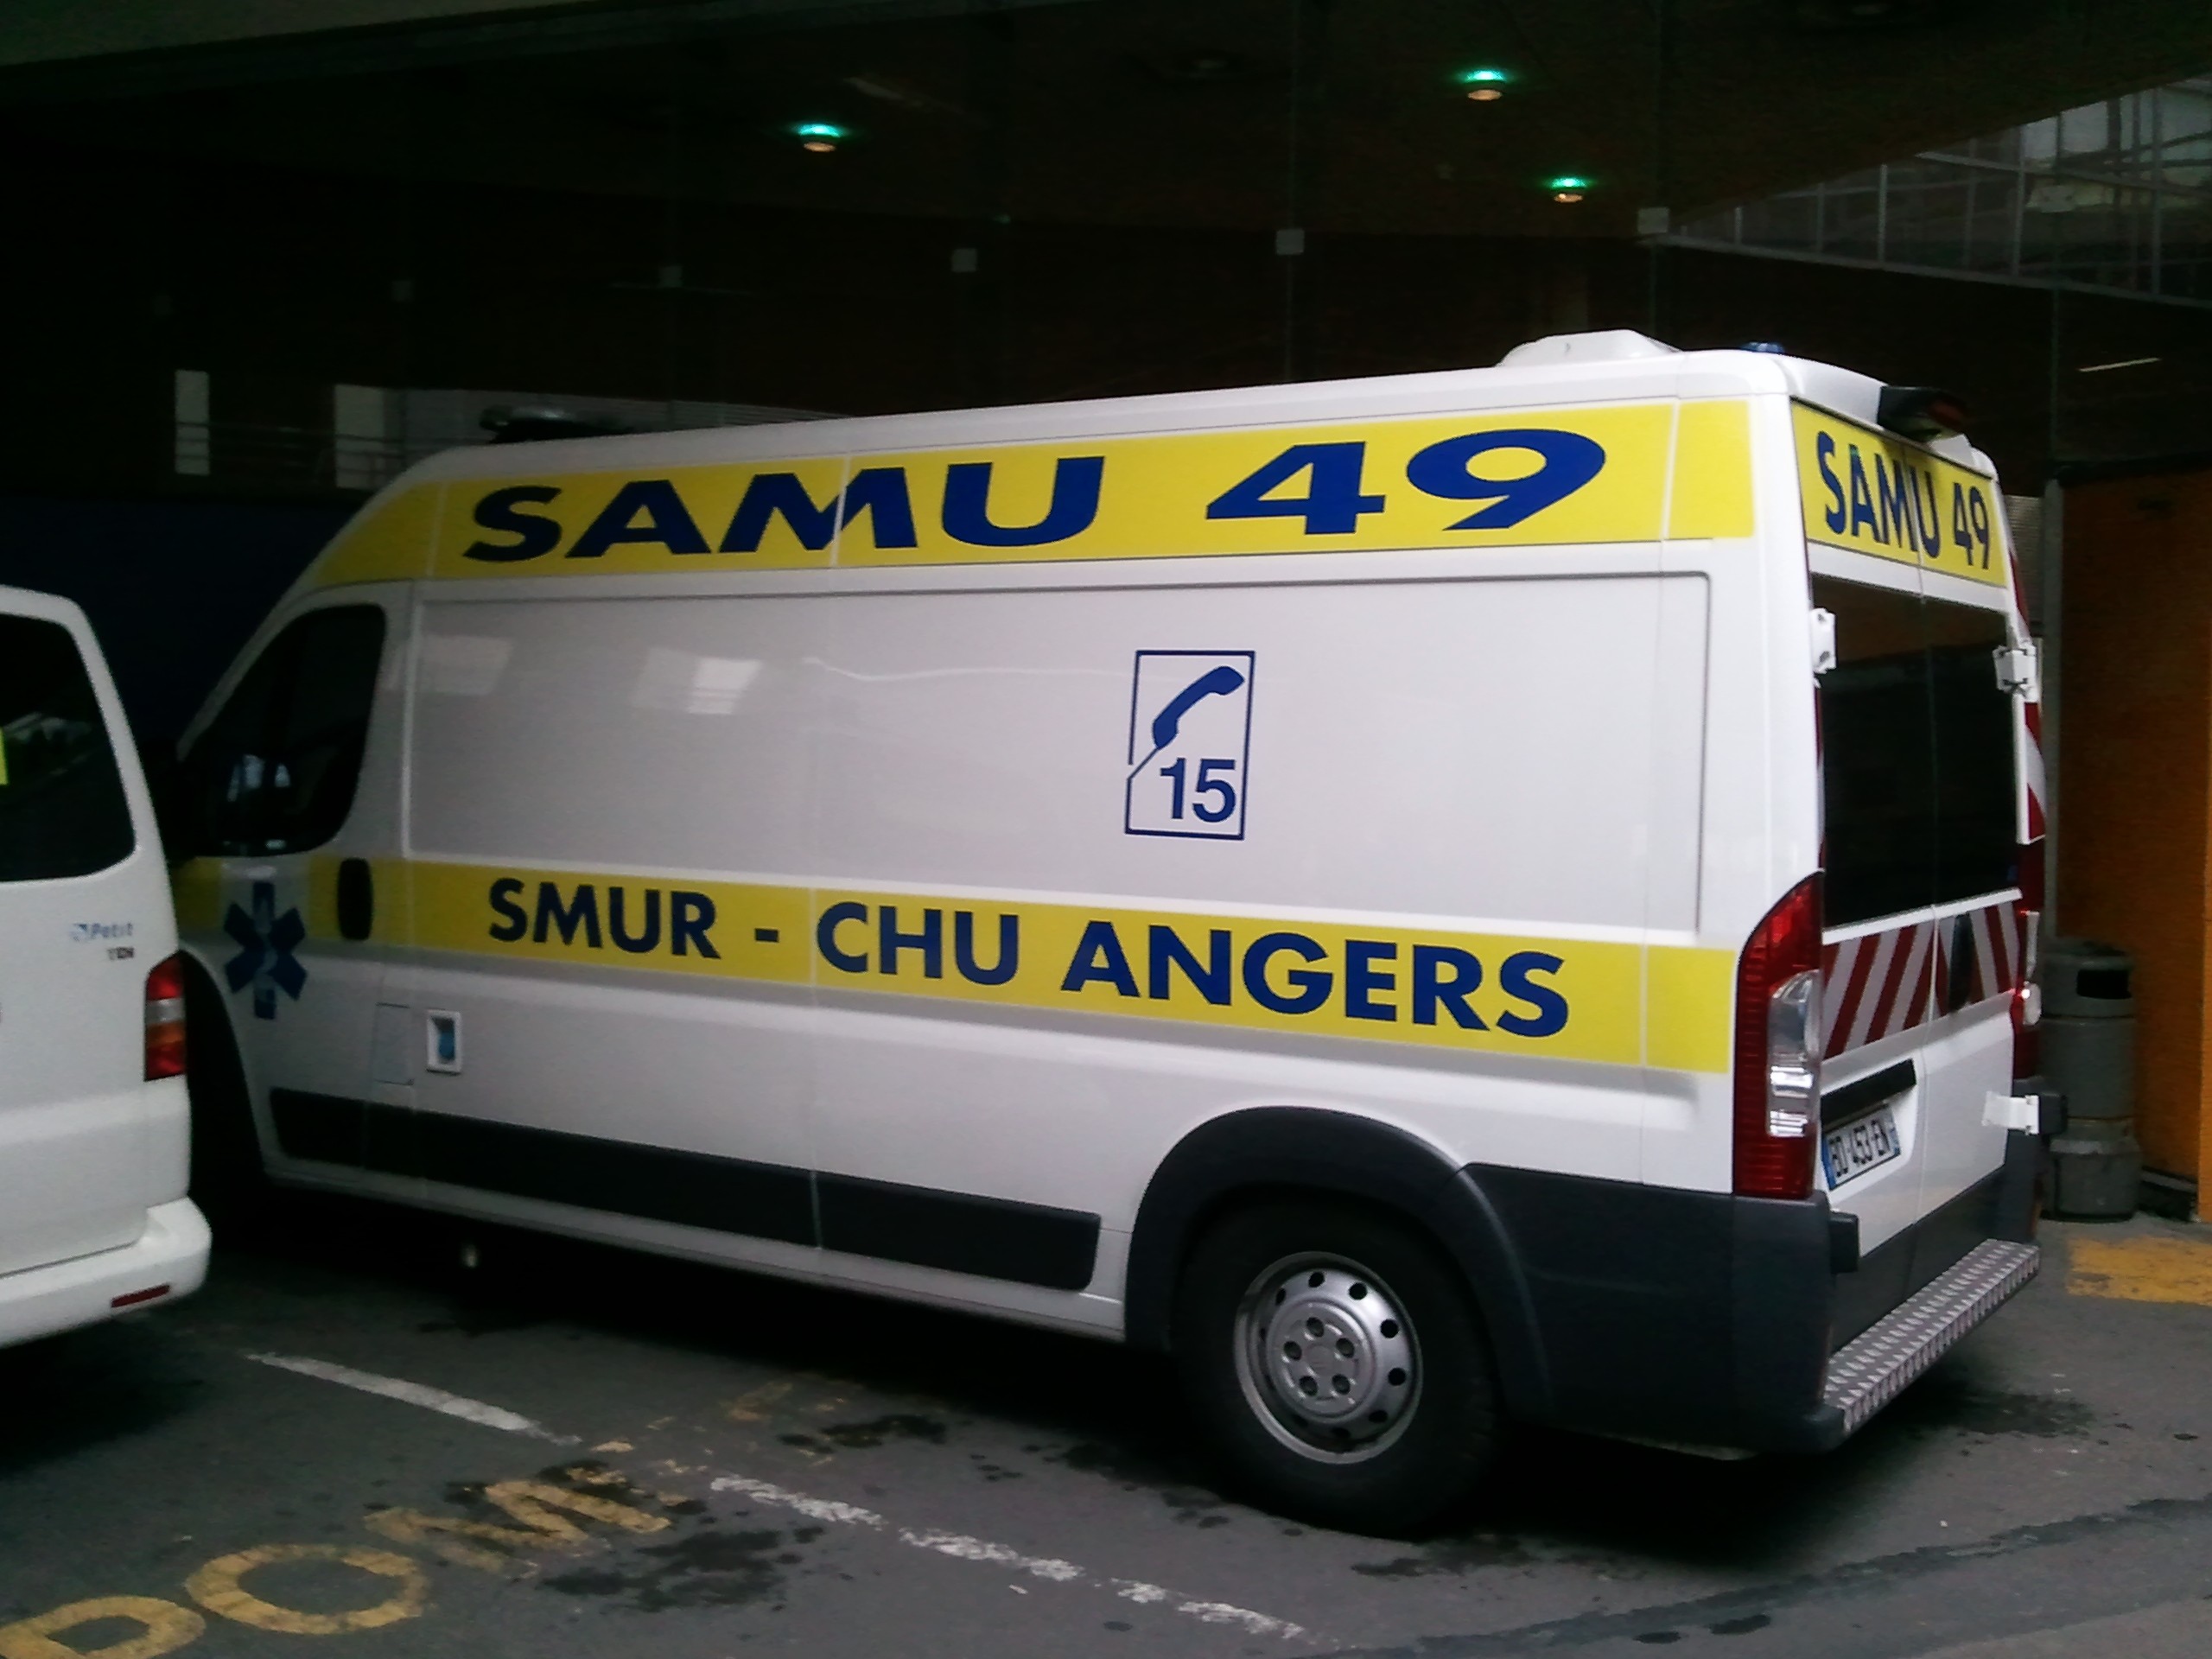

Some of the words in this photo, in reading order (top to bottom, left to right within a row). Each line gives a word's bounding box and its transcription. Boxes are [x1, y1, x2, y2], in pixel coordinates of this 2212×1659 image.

[462, 455, 1106, 562] SAMU
[1205, 428, 1607, 535] 49
[1816, 430, 1941, 559] SAMU
[1953, 481, 1991, 569] 49
[1159, 756, 1237, 823] 15
[488, 877, 721, 959] SMUR
[817, 901, 1020, 986] CHU
[1060, 919, 1569, 1038] ANGERS
